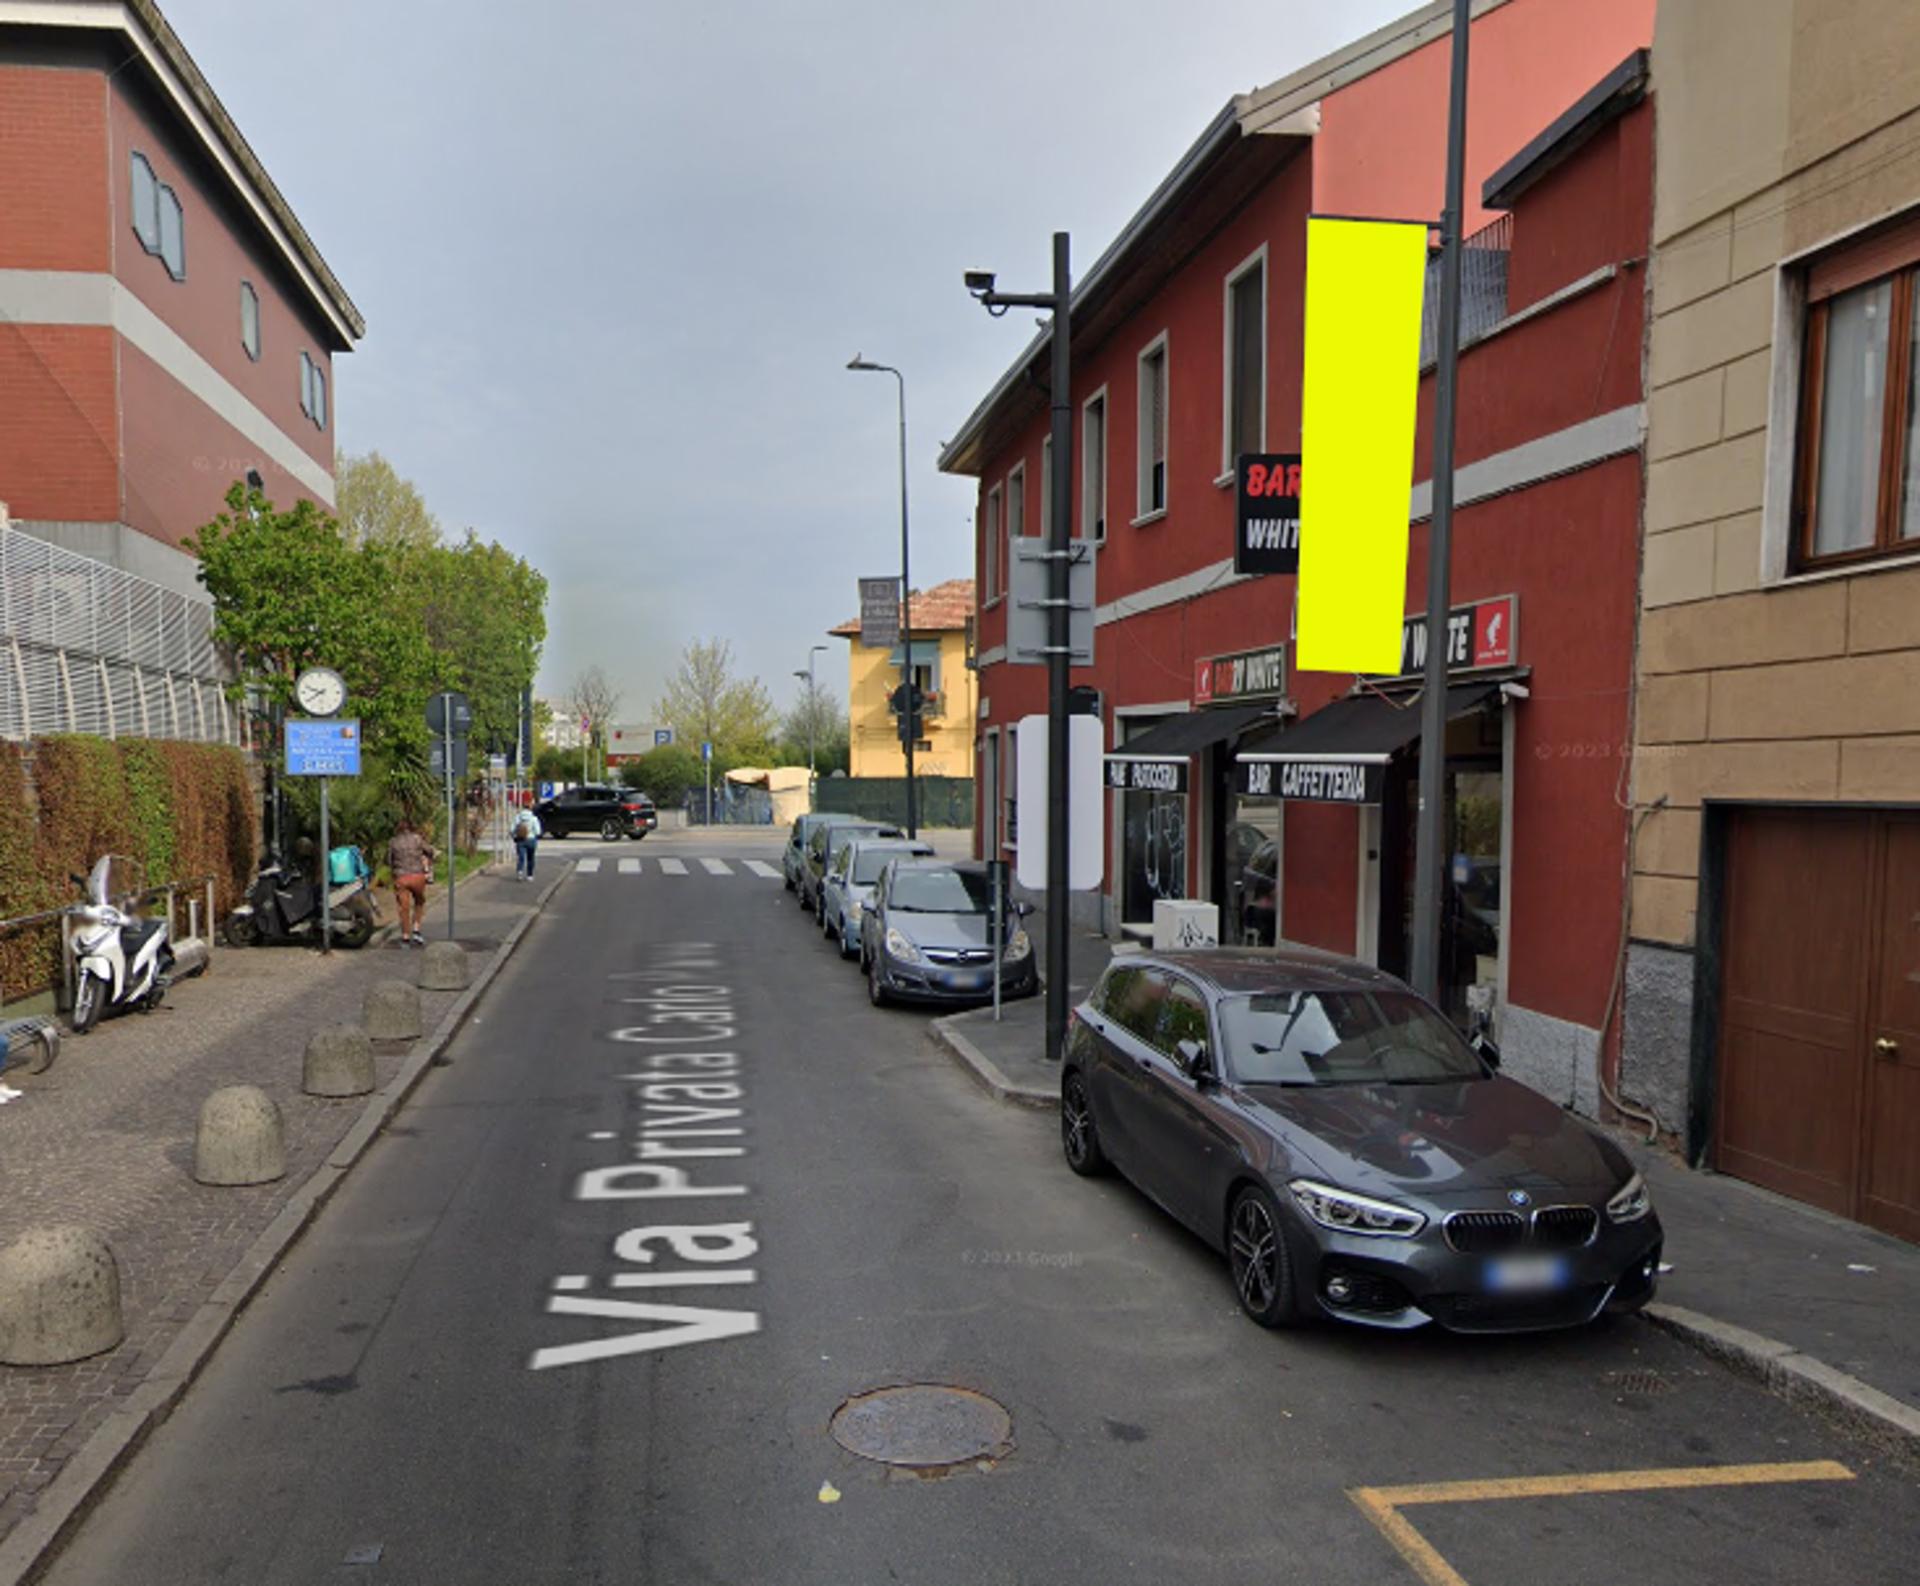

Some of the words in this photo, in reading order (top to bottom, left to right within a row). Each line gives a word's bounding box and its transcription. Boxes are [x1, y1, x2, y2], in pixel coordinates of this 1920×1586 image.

[1413, 615, 1469, 668] WTE
[1248, 763, 1272, 794] BAR
[1281, 763, 1366, 800] CAFFETTERIA
